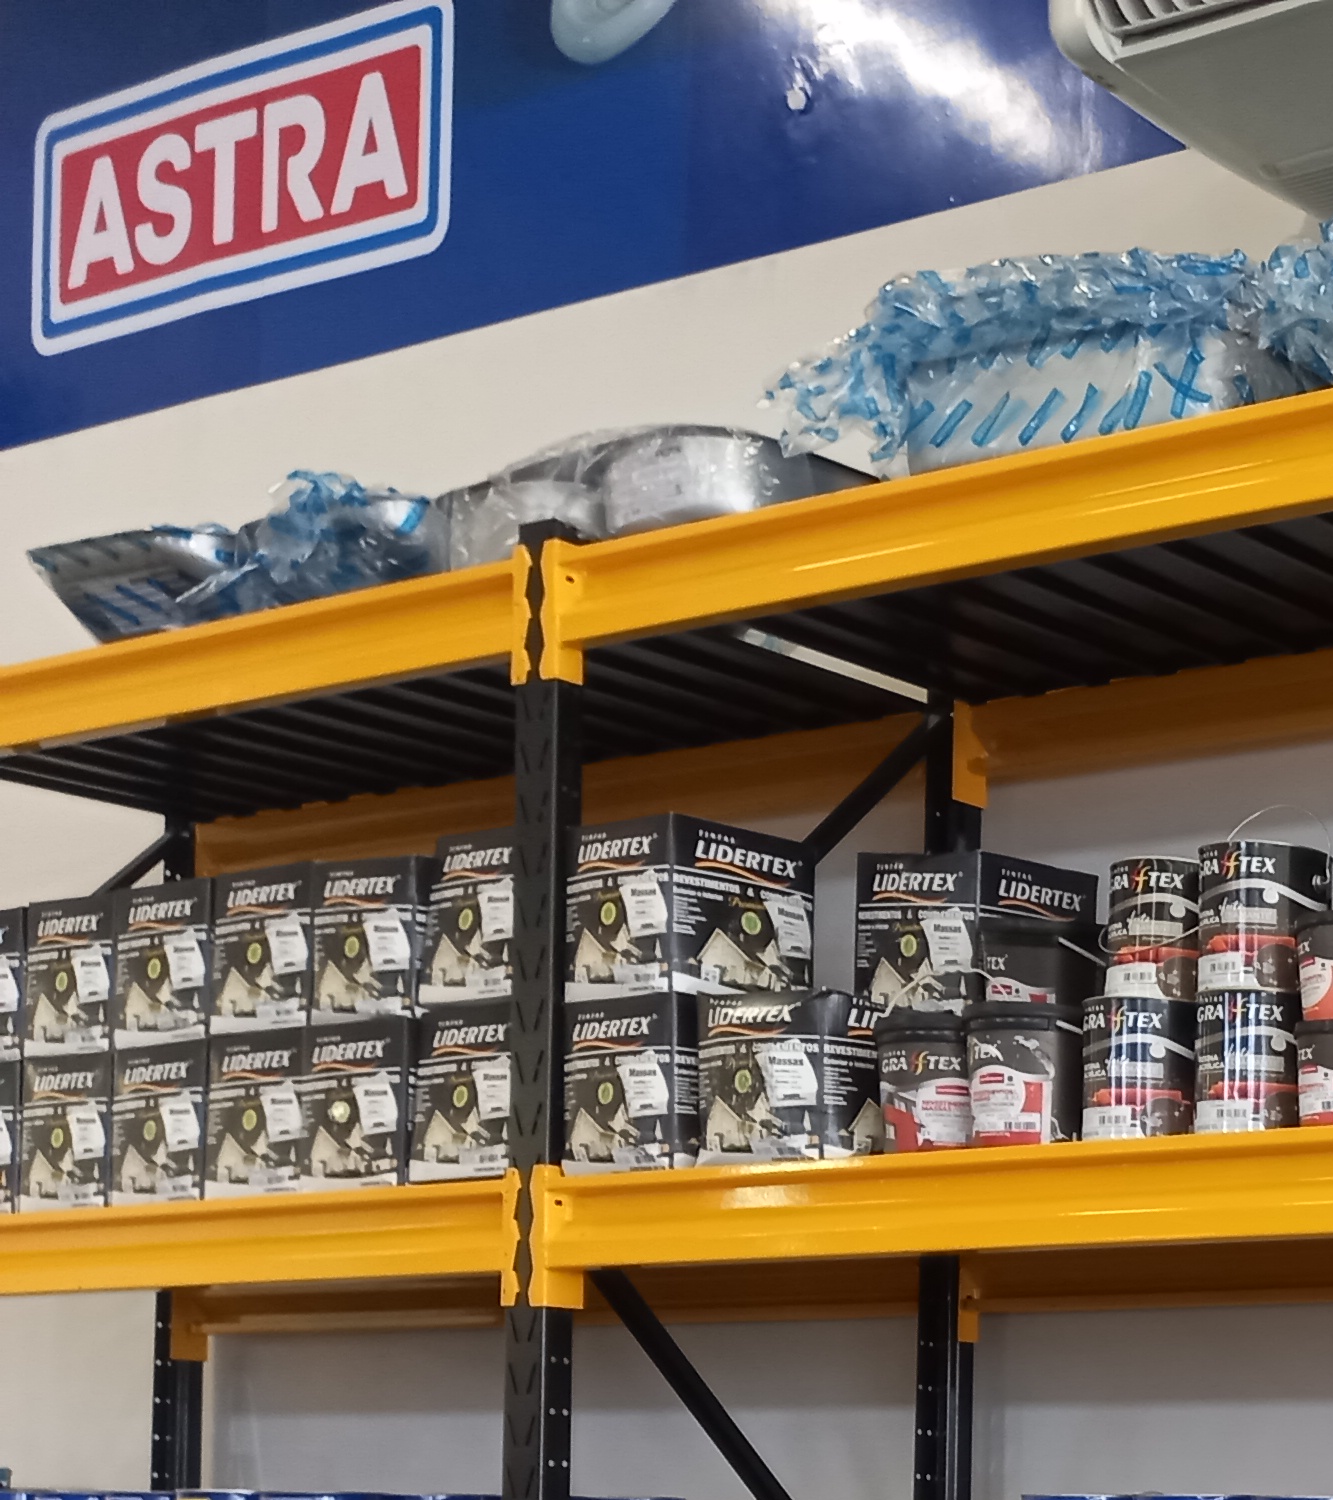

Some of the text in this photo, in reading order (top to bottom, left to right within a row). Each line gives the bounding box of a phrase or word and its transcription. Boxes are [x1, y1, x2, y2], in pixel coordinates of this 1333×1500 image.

[68, 70, 408, 289] ASTRA
[578, 836, 652, 864] LIDERTEX
[873, 872, 956, 893] LIDERTEX
[227, 884, 297, 908] LIDERTEX
[998, 878, 1082, 912] LIDERTEX
[37, 914, 98, 936] LIDERTEX
[573, 1017, 650, 1041] LIDERTEX
[312, 1040, 386, 1065] LIDERTEX
